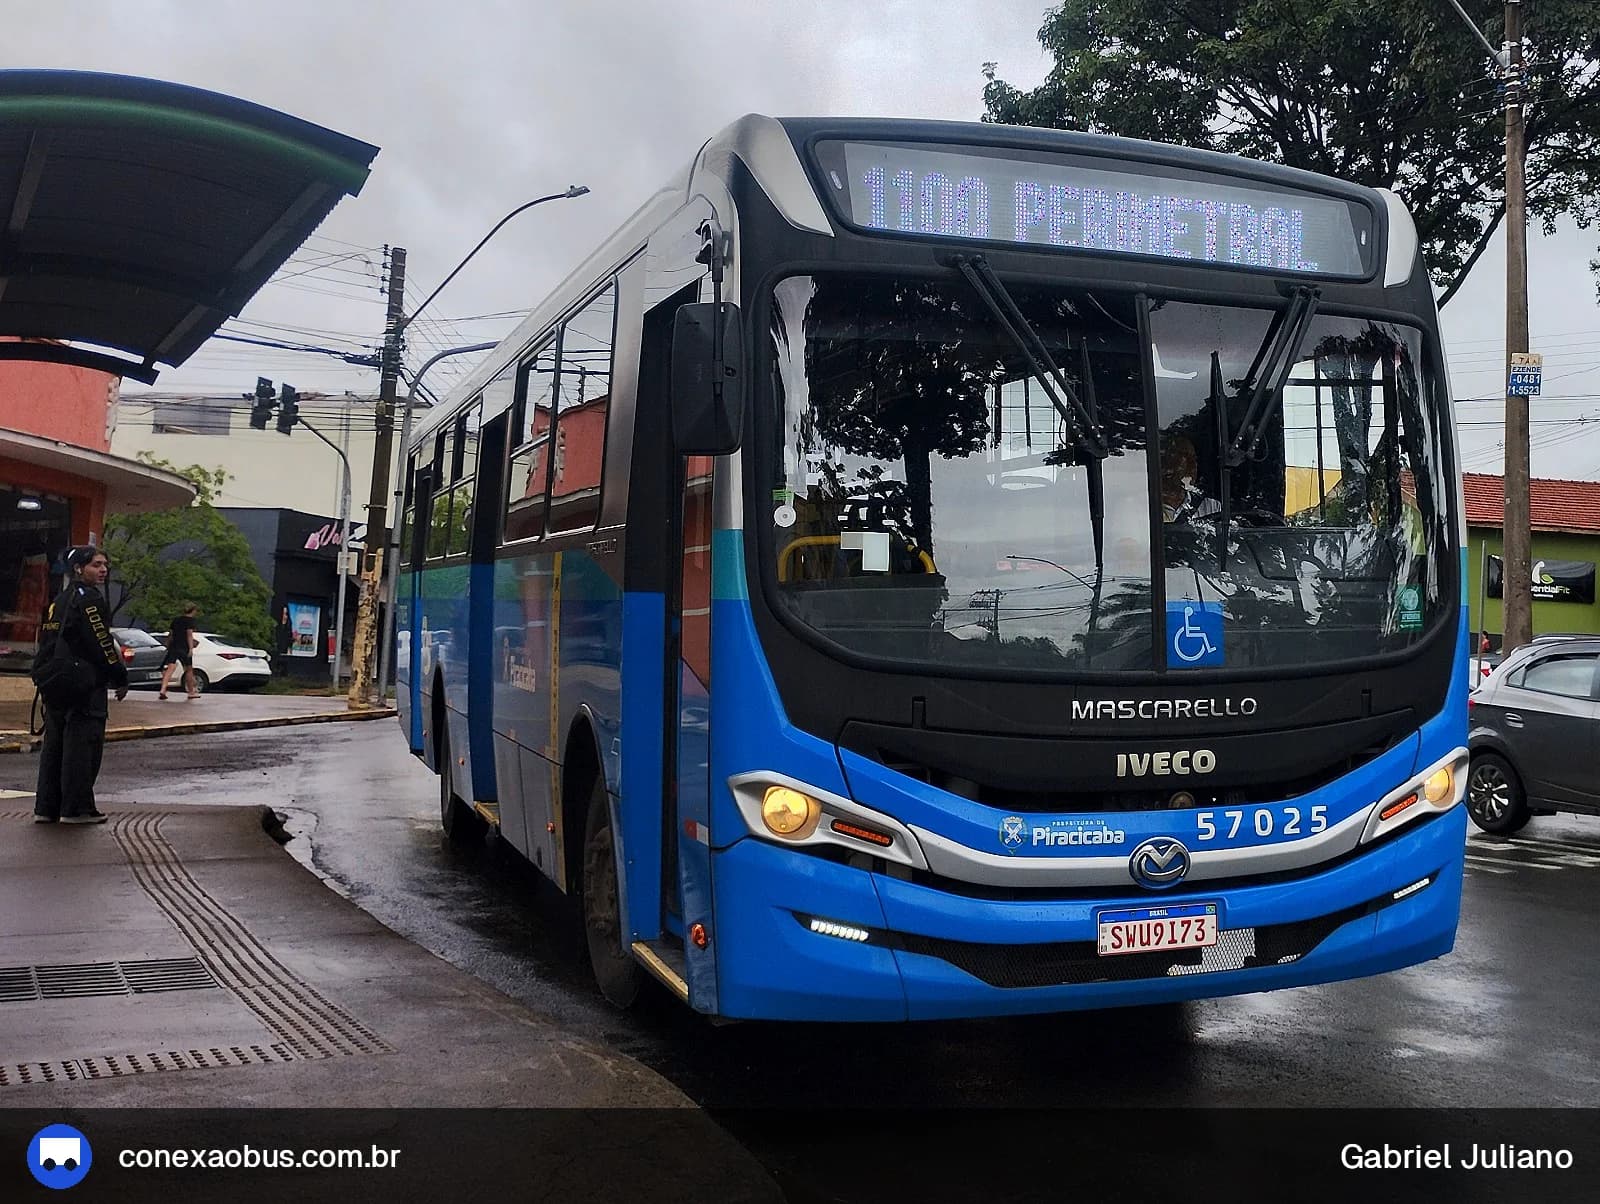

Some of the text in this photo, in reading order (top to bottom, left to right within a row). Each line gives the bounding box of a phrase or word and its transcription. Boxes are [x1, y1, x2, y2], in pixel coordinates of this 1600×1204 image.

[863, 167, 1319, 271] 1100 PERIMETRAL
[1072, 697, 1258, 720] MASCARELLO
[1116, 749, 1217, 777] IVECO
[1032, 825, 1126, 847] Piracicaba
[1196, 805, 1329, 841] 57025
[1149, 909, 1169, 917] BRASIL
[1110, 918, 1206, 950] SWU9I73
